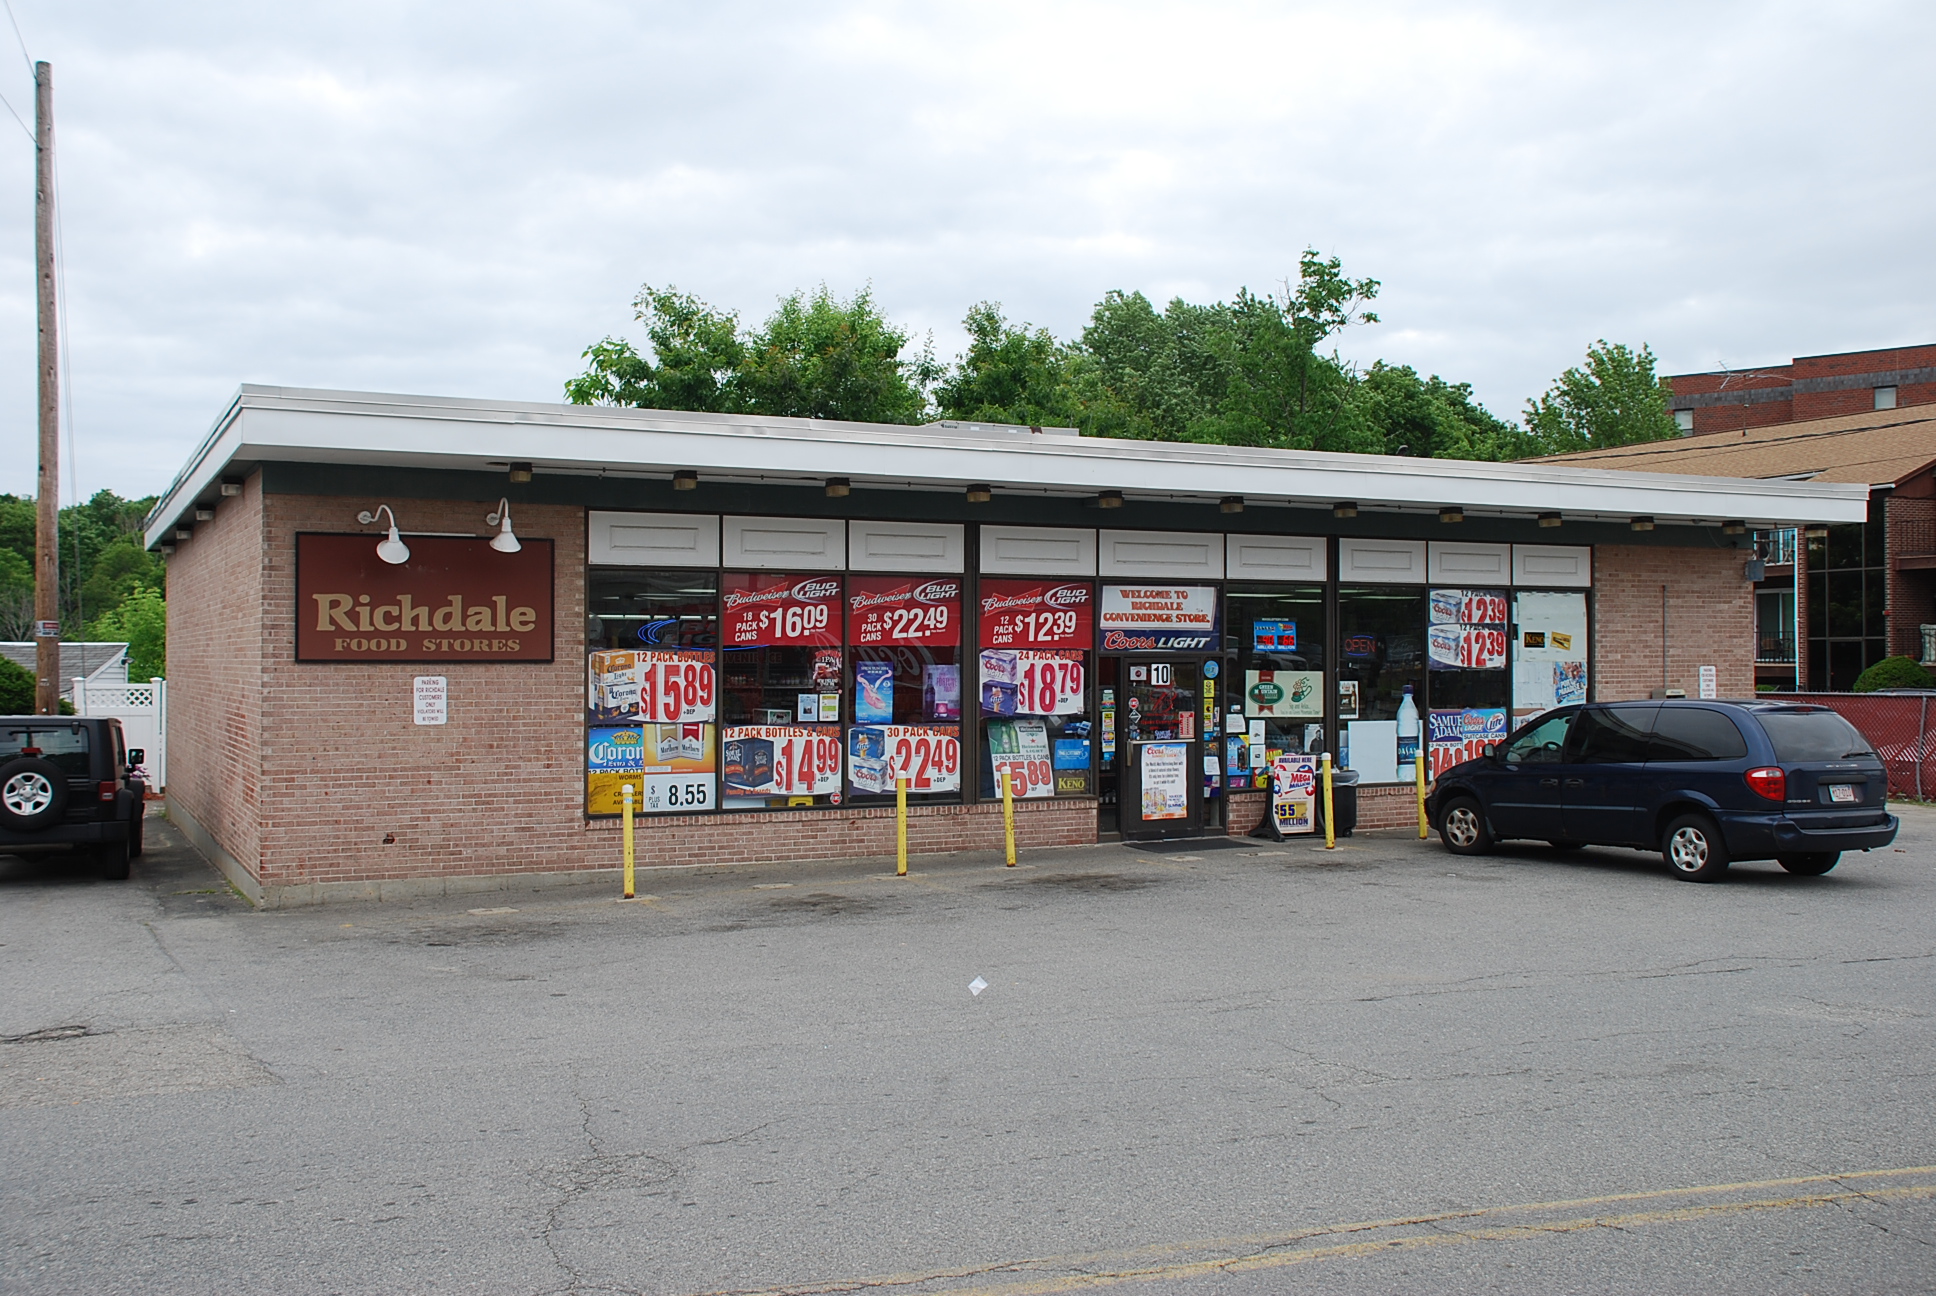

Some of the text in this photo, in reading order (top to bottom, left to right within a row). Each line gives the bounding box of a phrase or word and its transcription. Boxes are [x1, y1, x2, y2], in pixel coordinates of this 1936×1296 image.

[805, 582, 837, 591] BUD
[926, 584, 956, 593] BUD
[799, 588, 840, 598] LIGHT
[920, 590, 959, 600] LIGHT
[1056, 589, 1087, 597] BUD
[1120, 590, 1189, 600] WELCOME TO
[723, 590, 790, 607] Budweiser
[850, 591, 912, 609] Budweiser
[981, 595, 1043, 612] Budweiser
[1051, 595, 1089, 604] LIGHT
[1131, 601, 1183, 611] RICHDALE
[312, 593, 537, 632] Richdale
[743, 611, 753, 621] 18
[867, 613, 877, 622] 30
[1103, 612, 1173, 623] CONVENIENCE
[1000, 616, 1010, 624] 12
[736, 621, 758, 631] PACK
[861, 622, 882, 632] PACK
[993, 625, 1014, 634] PACK
[735, 631, 758, 642] CANS
[860, 632, 882, 642] CANS
[992, 634, 1013, 644] CANS
[1104, 630, 1211, 649] Coors LIGHT
[334, 638, 520, 652] FOOD STORES
[1345, 638, 1377, 653] OPEN
[636, 652, 716, 663] 12 PACK BOTTLES
[1018, 650, 1084, 661] 24 PACK CANS
[1153, 665, 1169, 684] 10
[1463, 714, 1485, 725] Coors
[724, 726, 841, 738] 12 PACK BOTTLES & CANS
[887, 726, 960, 738] 30 PACK CANS
[1464, 724, 1484, 732] LIGHT
[1290, 773, 1311, 783] MEGA
[1057, 777, 1085, 790] KENO
[650, 785, 656, 795] $
[668, 783, 707, 807] 8.55
[1279, 818, 1309, 826] MILLION
